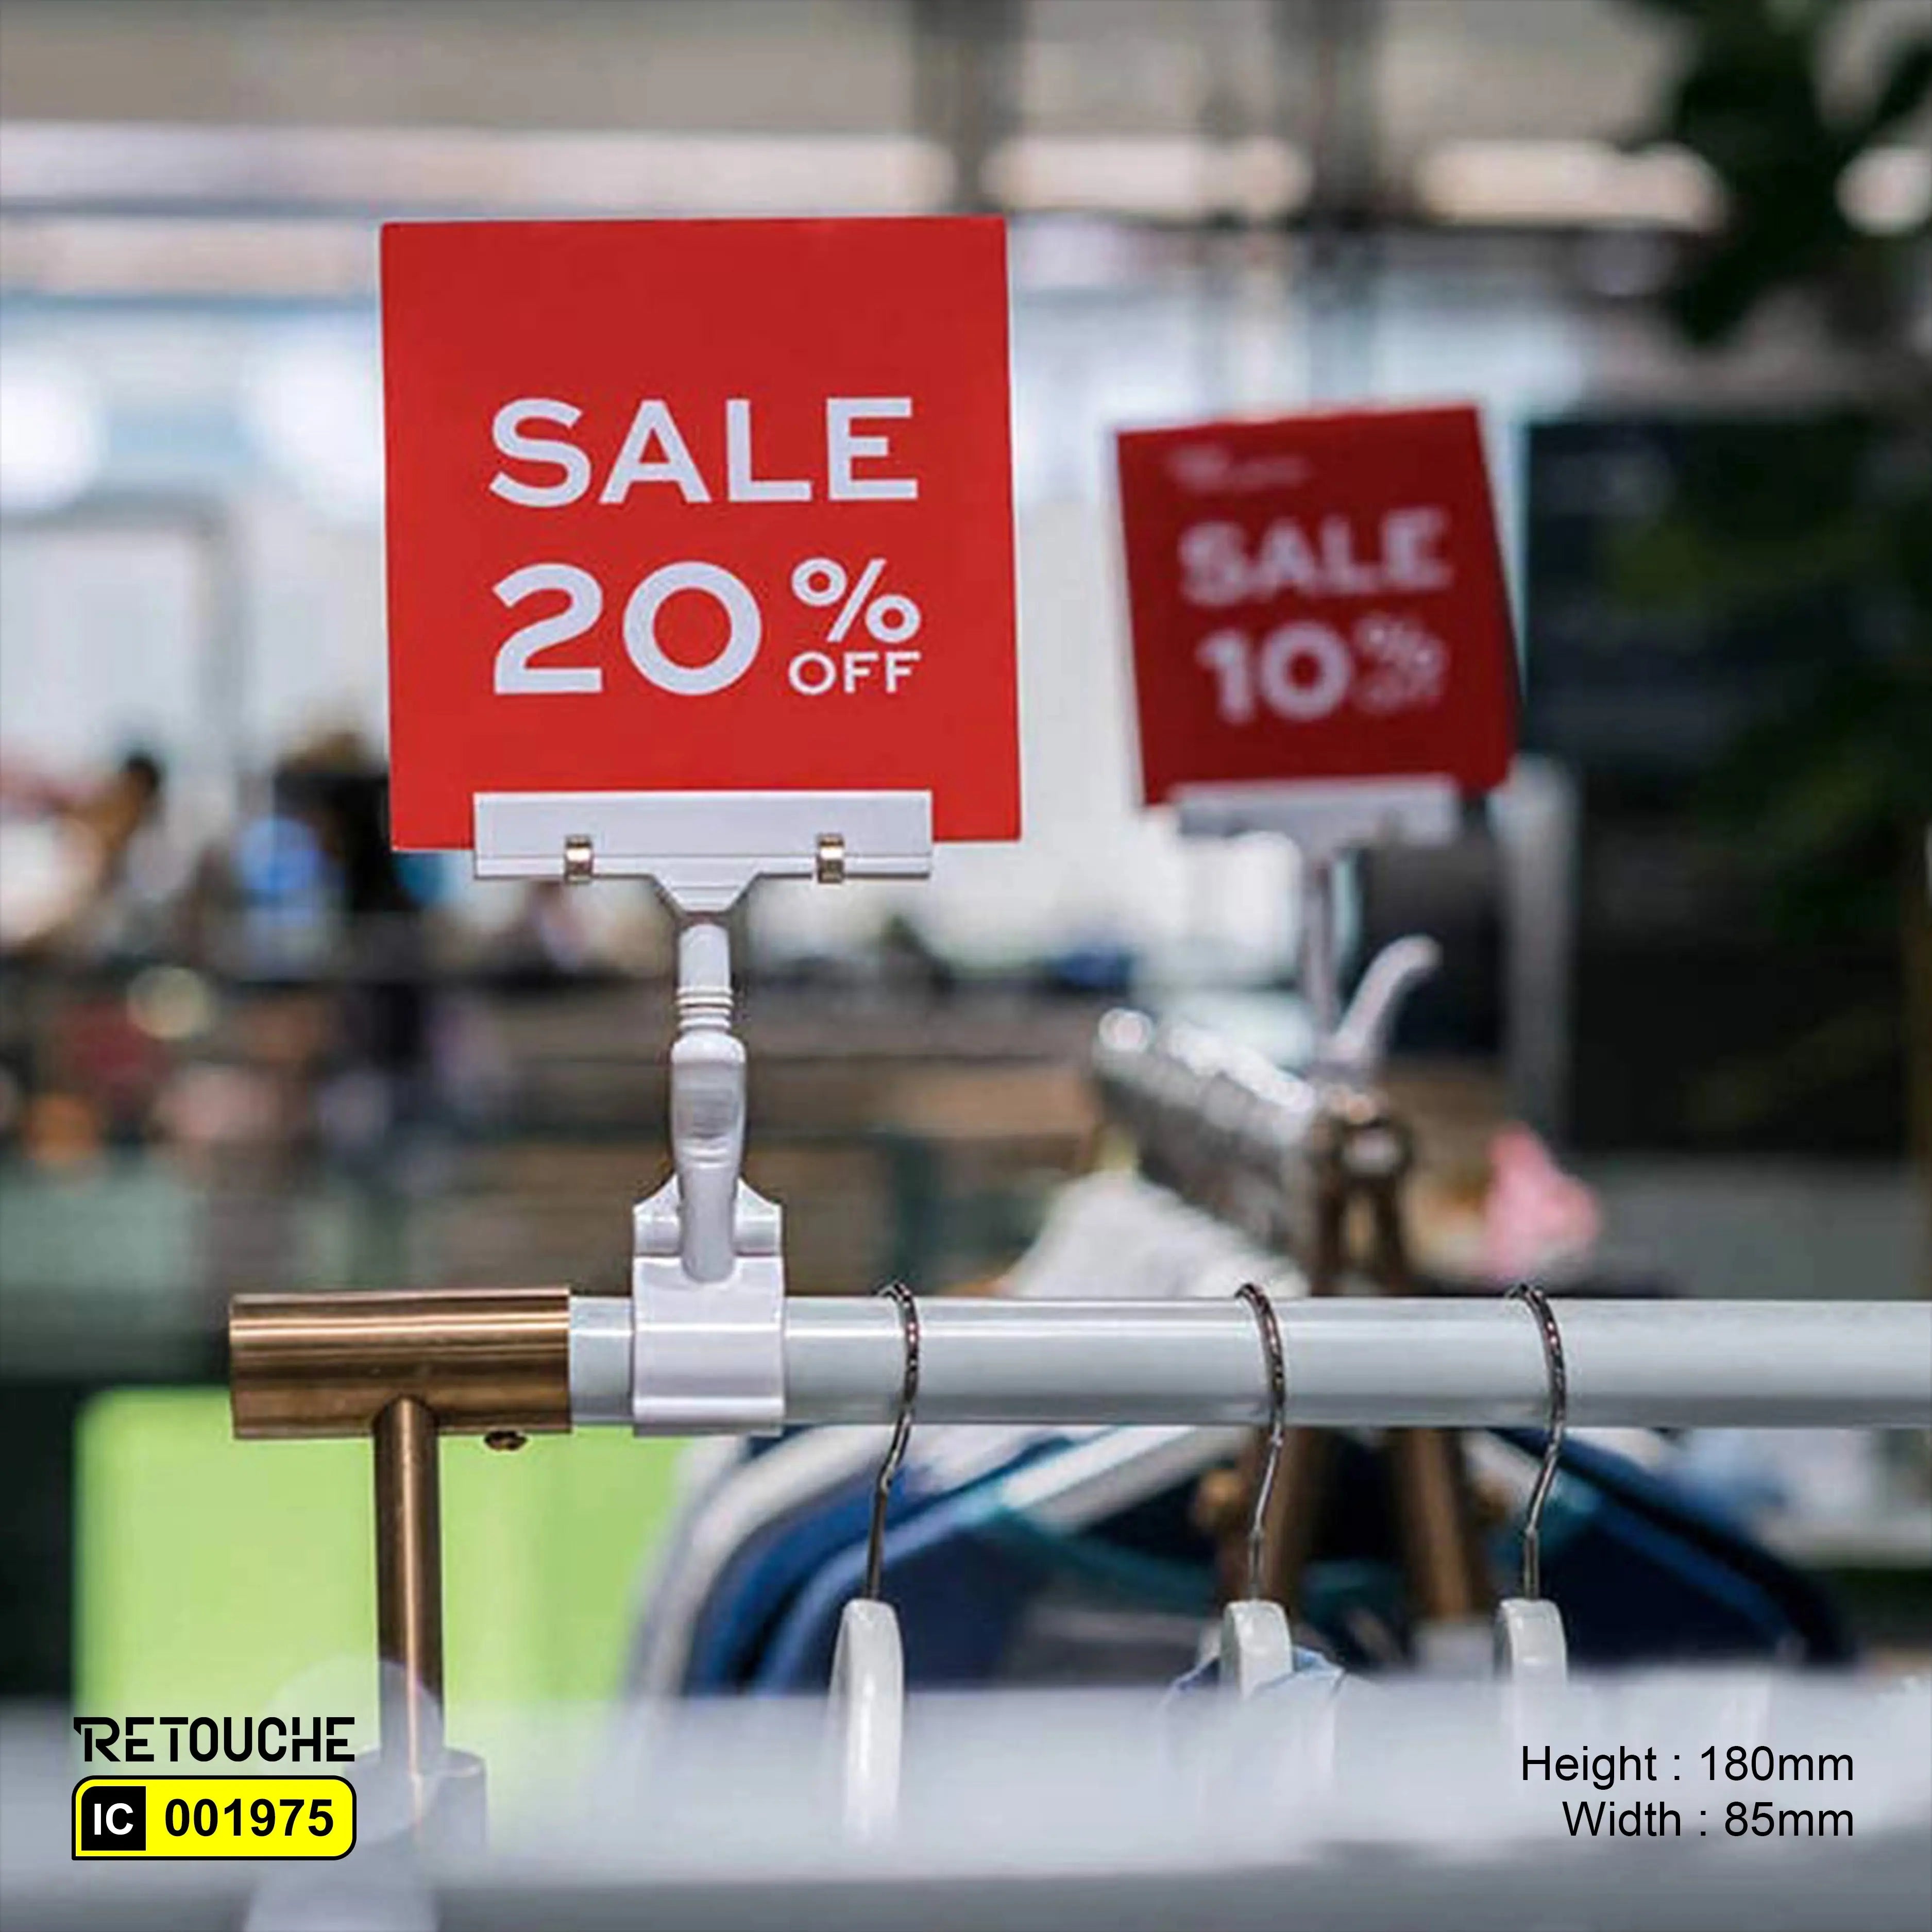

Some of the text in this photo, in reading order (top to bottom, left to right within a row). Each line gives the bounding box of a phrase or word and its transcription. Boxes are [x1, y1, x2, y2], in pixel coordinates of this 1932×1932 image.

[489, 397, 918, 507] SALE
[1179, 506, 1451, 608] SALE
[788, 651, 921, 696] OFF
